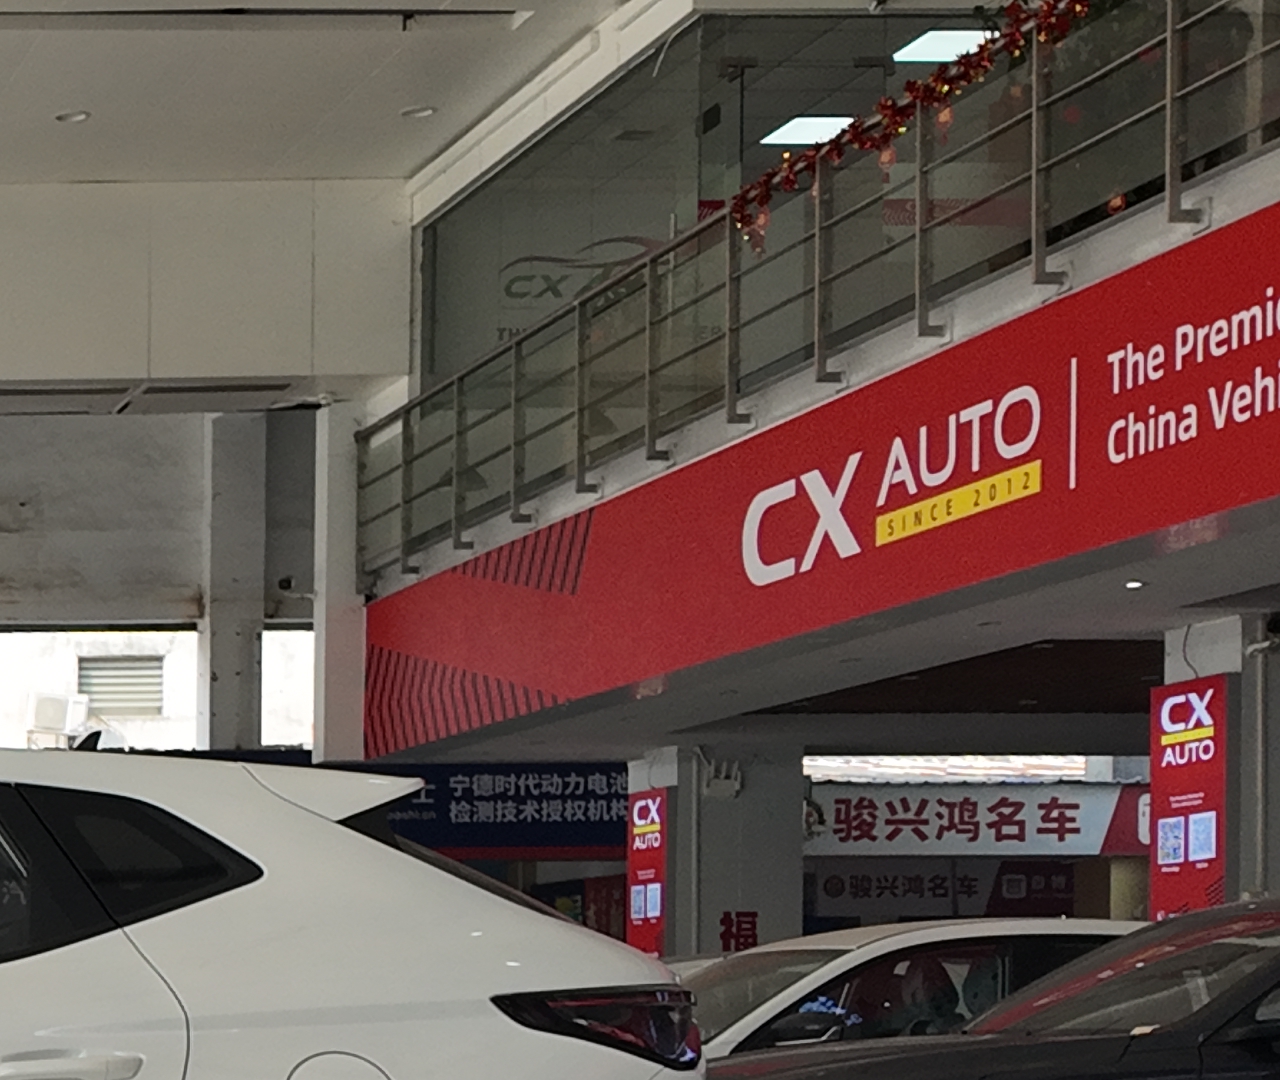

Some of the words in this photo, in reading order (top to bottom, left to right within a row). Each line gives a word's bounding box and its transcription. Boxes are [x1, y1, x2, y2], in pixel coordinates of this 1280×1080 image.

[1107, 342, 1165, 394] The
[1175, 286, 1280, 371] Premi
[1107, 403, 1198, 464] China
[742, 451, 863, 587] CX
[876, 385, 1041, 507] AUTO
[886, 498, 954, 537] SINCE
[973, 471, 1031, 507] 2012
[1161, 688, 1214, 733] CX
[1161, 739, 1214, 767] AUTO
[449, 772, 628, 797] 宁德时代动力电池
[449, 800, 628, 824] 检测技术授权机构
[633, 796, 662, 826] CX
[833, 797, 1082, 843] 骏兴鸿名车
[633, 832, 661, 850] AUTO
[848, 873, 979, 899] 骏兴鸿名车
[719, 911, 758, 952] 福
